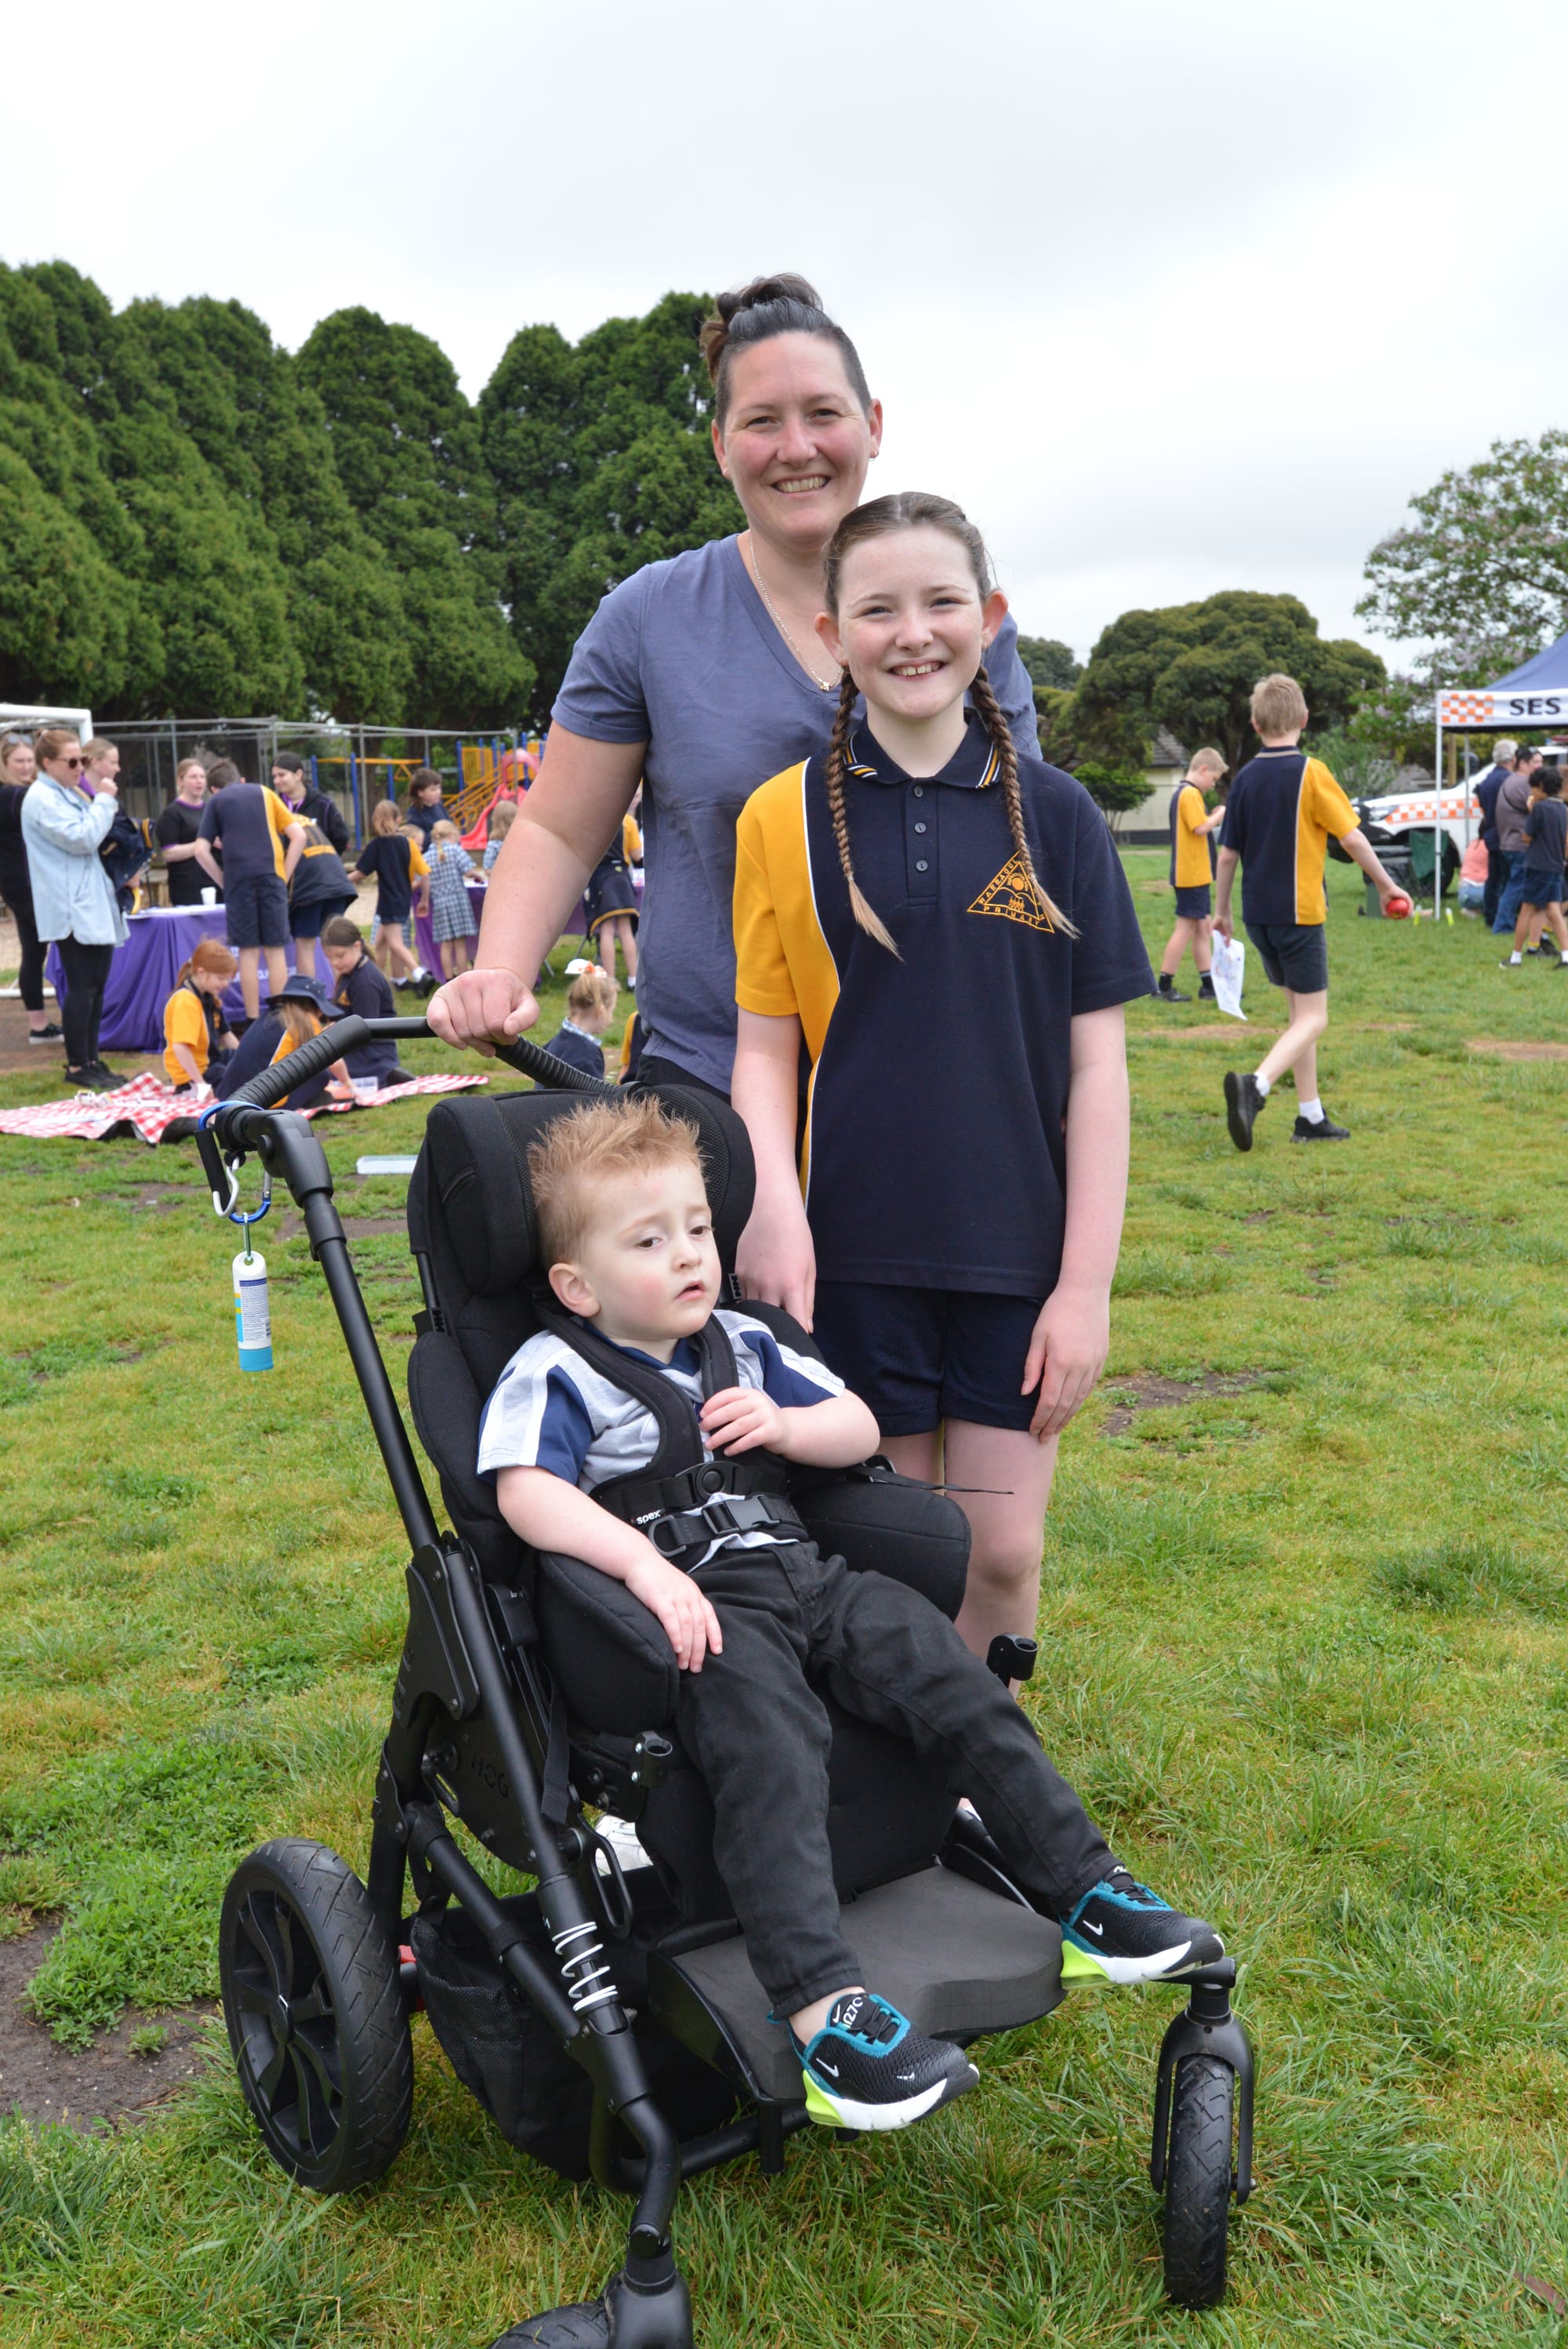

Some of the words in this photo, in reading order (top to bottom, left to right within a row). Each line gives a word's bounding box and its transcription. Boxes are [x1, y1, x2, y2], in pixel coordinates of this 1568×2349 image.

[1510, 697, 1561, 717] SES
[984, 906, 1040, 927] PRIMARY
[637, 1509, 661, 1525] spex
